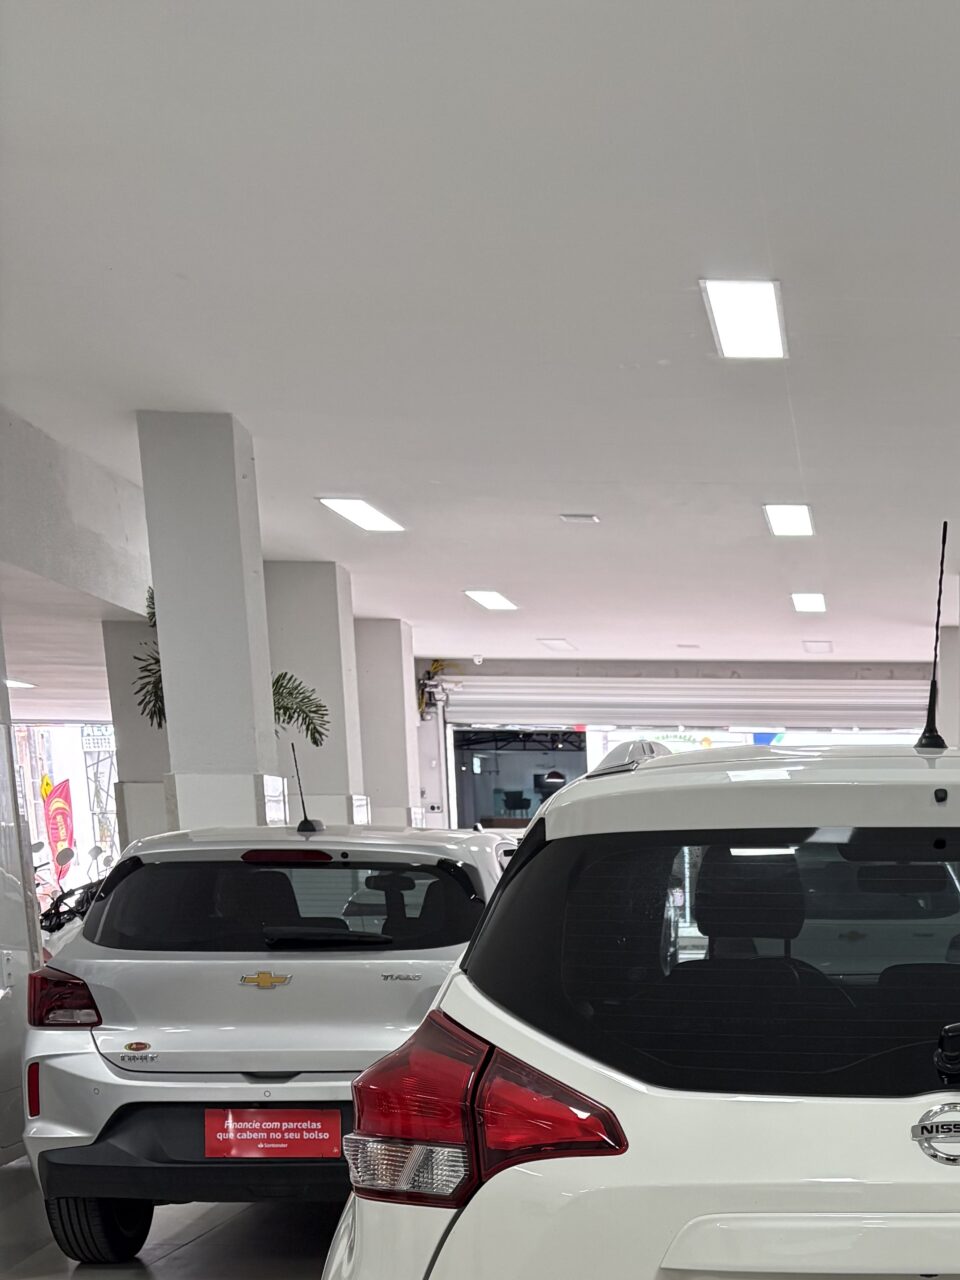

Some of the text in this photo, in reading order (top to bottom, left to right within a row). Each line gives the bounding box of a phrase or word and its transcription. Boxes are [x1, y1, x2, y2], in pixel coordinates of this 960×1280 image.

[224, 1120, 260, 1129] Financie
[282, 1120, 322, 1130] parcelas
[216, 1132, 234, 1141] que
[236, 1131, 267, 1139] cabem
[303, 1130, 330, 1139] bolso
